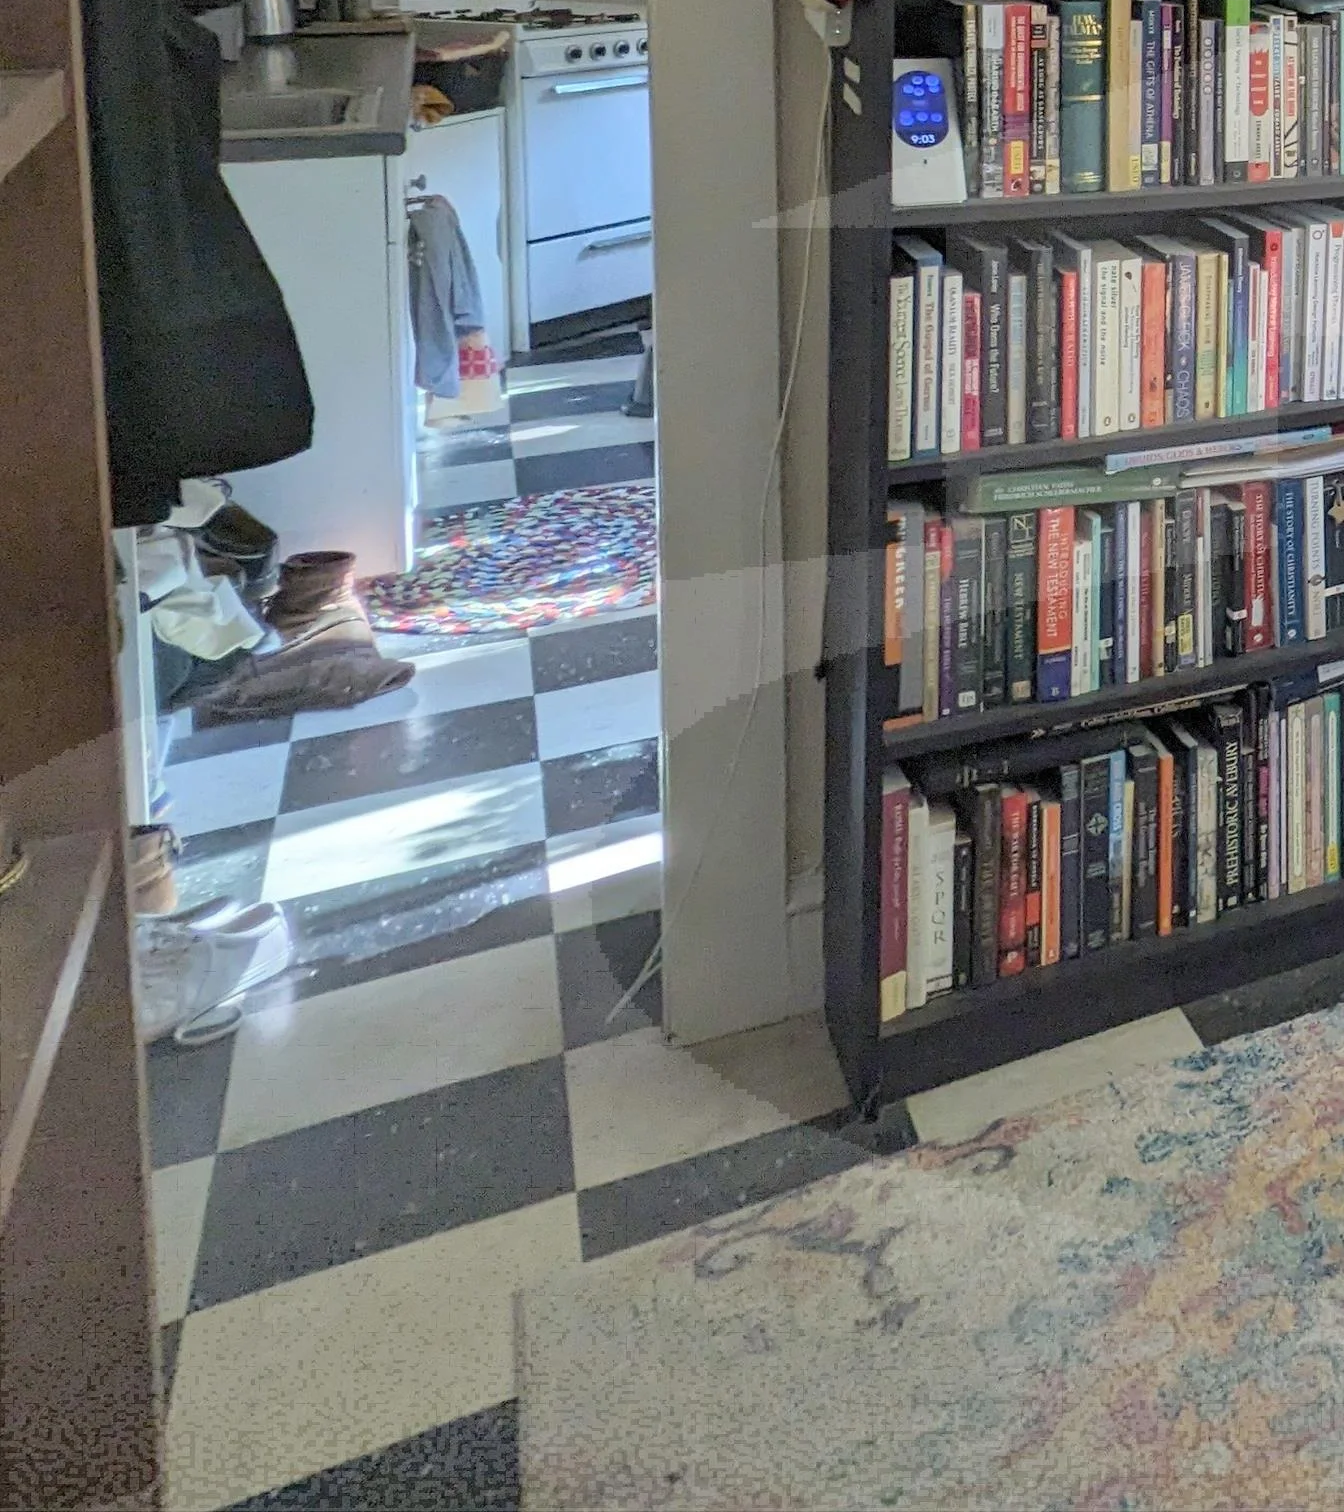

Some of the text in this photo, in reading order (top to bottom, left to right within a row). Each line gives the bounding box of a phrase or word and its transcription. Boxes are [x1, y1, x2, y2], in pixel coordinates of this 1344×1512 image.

[1144, 40, 1156, 139] THE GIFTS OF ATHENA
[911, 133, 936, 146] 9:03
[1110, 265, 1118, 309] nate silver
[1330, 243, 1342, 294] Programming
[921, 302, 935, 322] The
[989, 303, 1000, 324] Who
[1098, 267, 1109, 366] the signal and the noise
[889, 340, 911, 381] Science
[921, 324, 935, 361] Gospel
[948, 324, 960, 356] REALITY
[990, 350, 1000, 363] the
[989, 363, 1000, 393] Future?
[1176, 369, 1191, 418] CHAOS
[1254, 493, 1266, 541] THE STORY
[1310, 480, 1320, 569] TURNING POINTS
[1045, 517, 1059, 637] THE NEW TESTAMENT
[1058, 532, 1069, 620] INTRODUCING
[1285, 490, 1297, 616] THE STORY OF CHRISTIANITY
[959, 578, 970, 648] HEBREW BIBLE
[1013, 573, 1025, 660] NEW TESTAMENT
[1225, 741, 1240, 886] PREHISTORIC AVEBURY
[931, 870, 946, 945] SPQR
